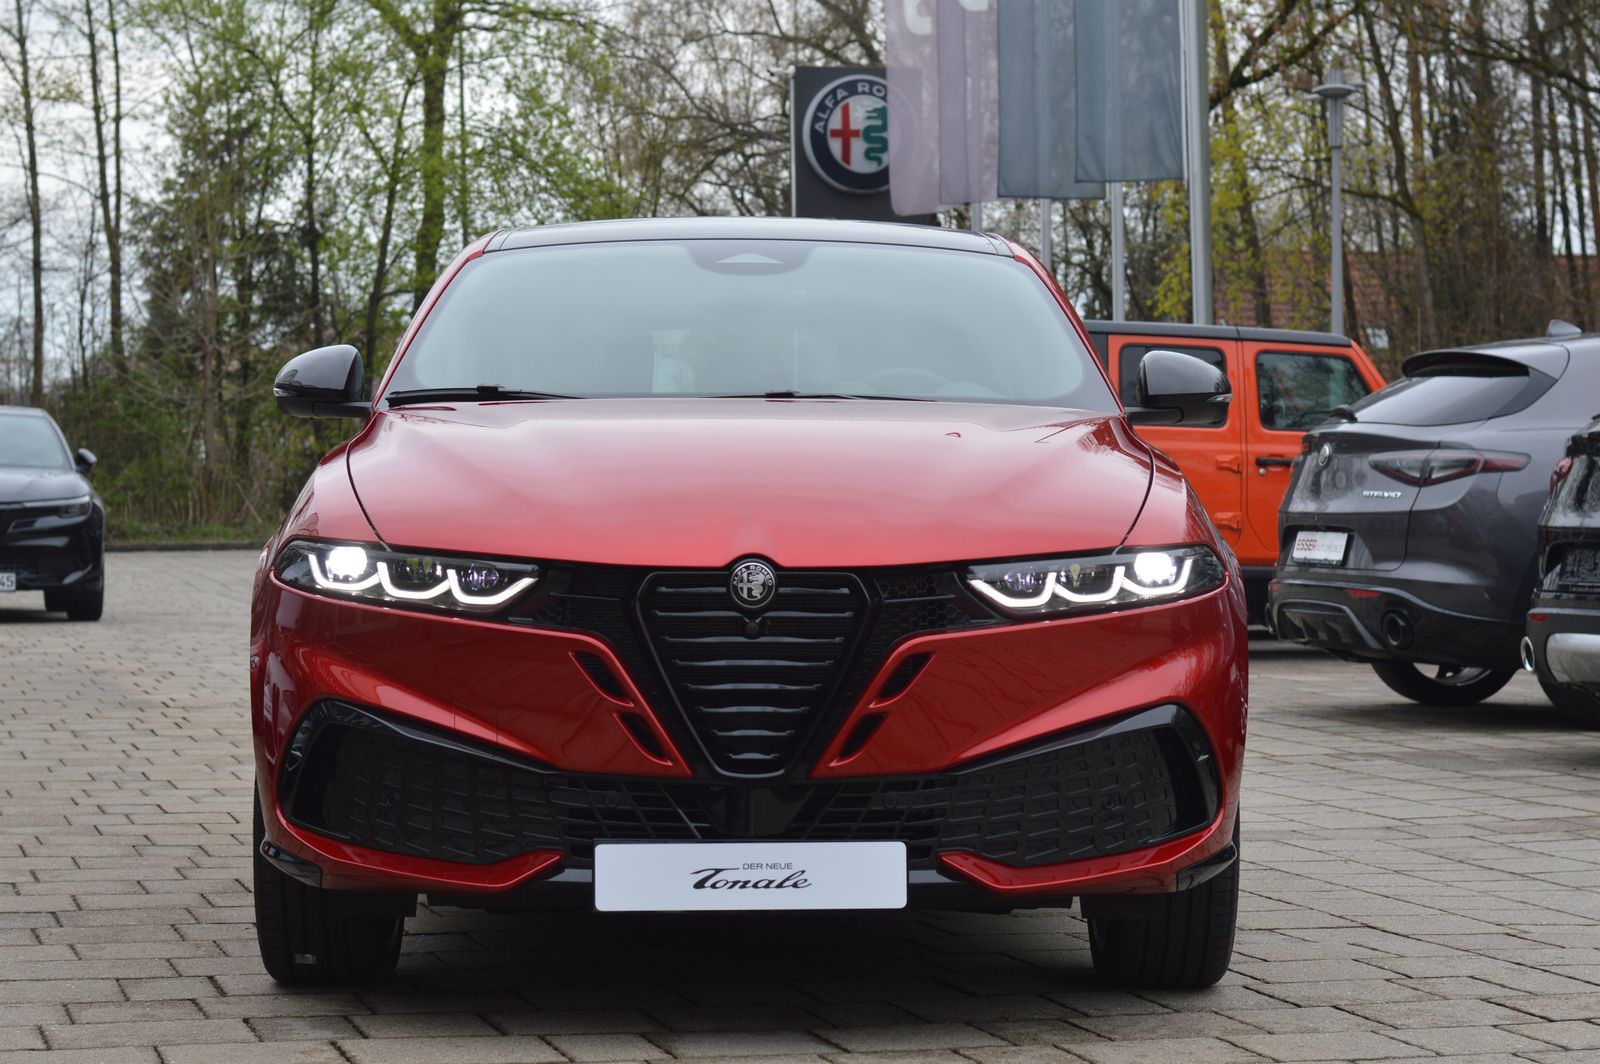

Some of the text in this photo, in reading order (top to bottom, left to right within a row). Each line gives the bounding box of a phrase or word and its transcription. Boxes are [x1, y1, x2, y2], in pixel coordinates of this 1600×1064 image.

[814, 88, 849, 134] ALFA
[1363, 490, 1402, 498] STELVIO
[1296, 538, 1317, 552] ESSER
[733, 565, 772, 586] ALFA ROMEO
[765, 862, 793, 870] NEUE
[690, 868, 812, 889] Tonale
